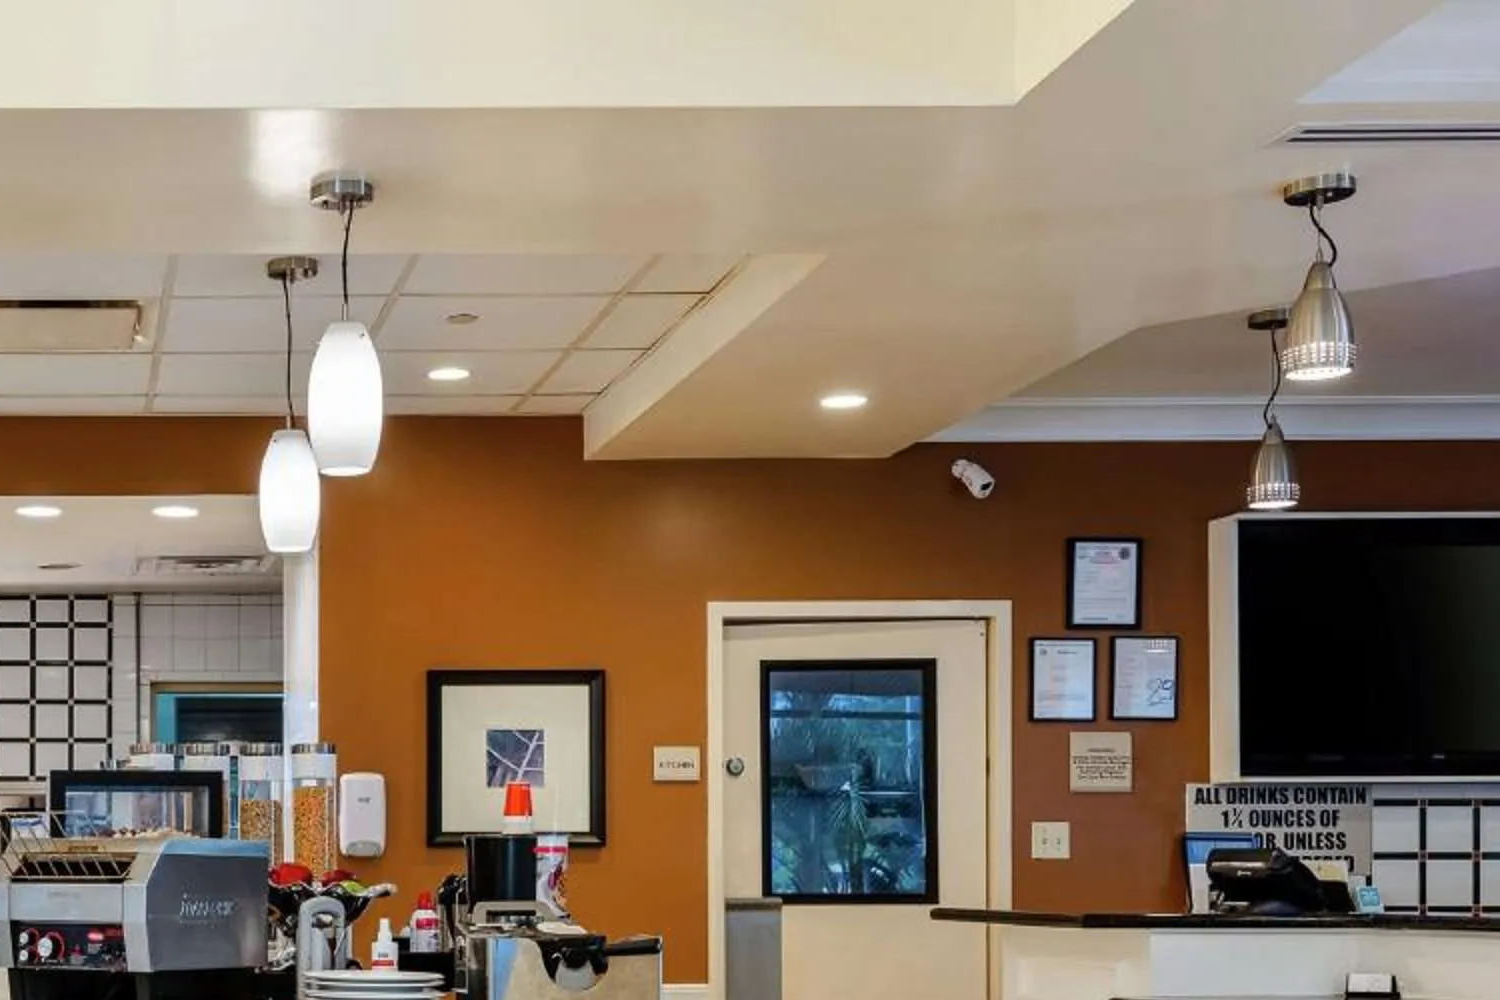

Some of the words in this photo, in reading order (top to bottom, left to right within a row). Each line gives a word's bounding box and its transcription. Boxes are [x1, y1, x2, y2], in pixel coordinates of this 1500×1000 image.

[1194, 787, 1223, 805] ALL
[1227, 787, 1289, 805] DRINKS
[1293, 787, 1367, 805] CONTAIN
[1250, 809, 1315, 828] OUNCES
[1320, 809, 1340, 828] OF
[1284, 832, 1347, 850] UNLESS
